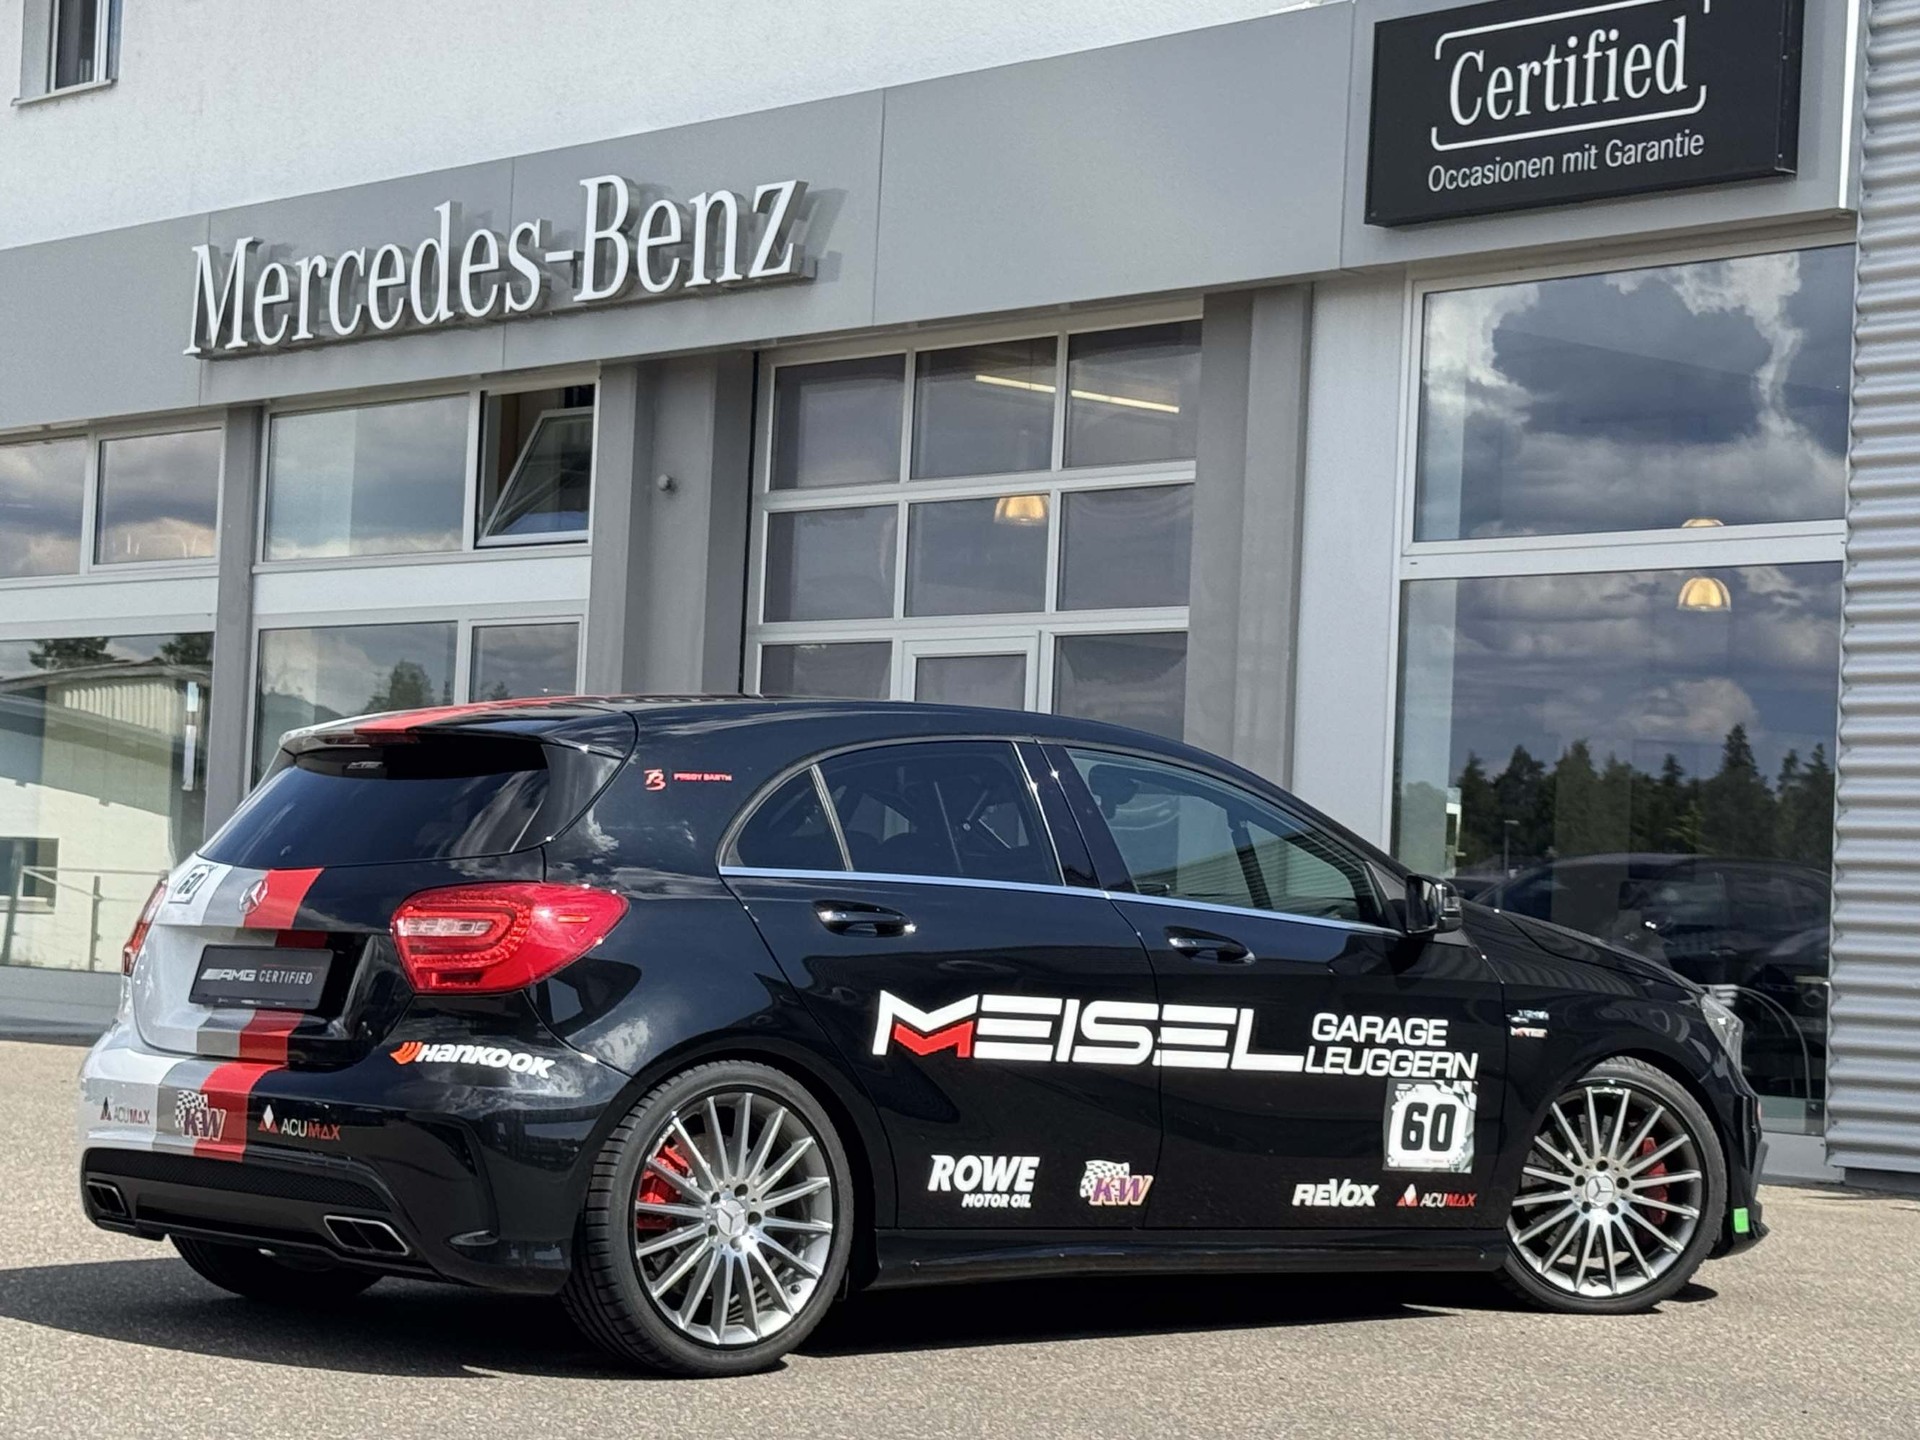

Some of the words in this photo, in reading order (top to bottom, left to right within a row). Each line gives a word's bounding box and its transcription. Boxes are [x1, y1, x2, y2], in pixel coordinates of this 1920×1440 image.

[1448, 14, 1689, 127] Certified
[1428, 152, 1555, 193] Occasionen
[1562, 143, 1599, 174] mit
[1605, 128, 1705, 167] Garantie
[183, 173, 805, 356] Mercedes-Benz
[217, 967, 257, 982] AMG
[259, 969, 314, 986] CERTIFIED
[871, 989, 1305, 1073] MEISEL
[1311, 1012, 1449, 1047] GARAGE
[1304, 1045, 1479, 1080] LEUGGERN
[183, 1107, 227, 1142] KW
[280, 1117, 341, 1141] ACUMAX
[1401, 1101, 1457, 1153] 60
[927, 1154, 1041, 1192] ROWE
[1089, 1174, 1155, 1207] KW
[961, 1193, 1010, 1209] MOTOR
[1011, 1193, 1032, 1209] OIL
[1420, 1192, 1478, 1208] ACUMAX
